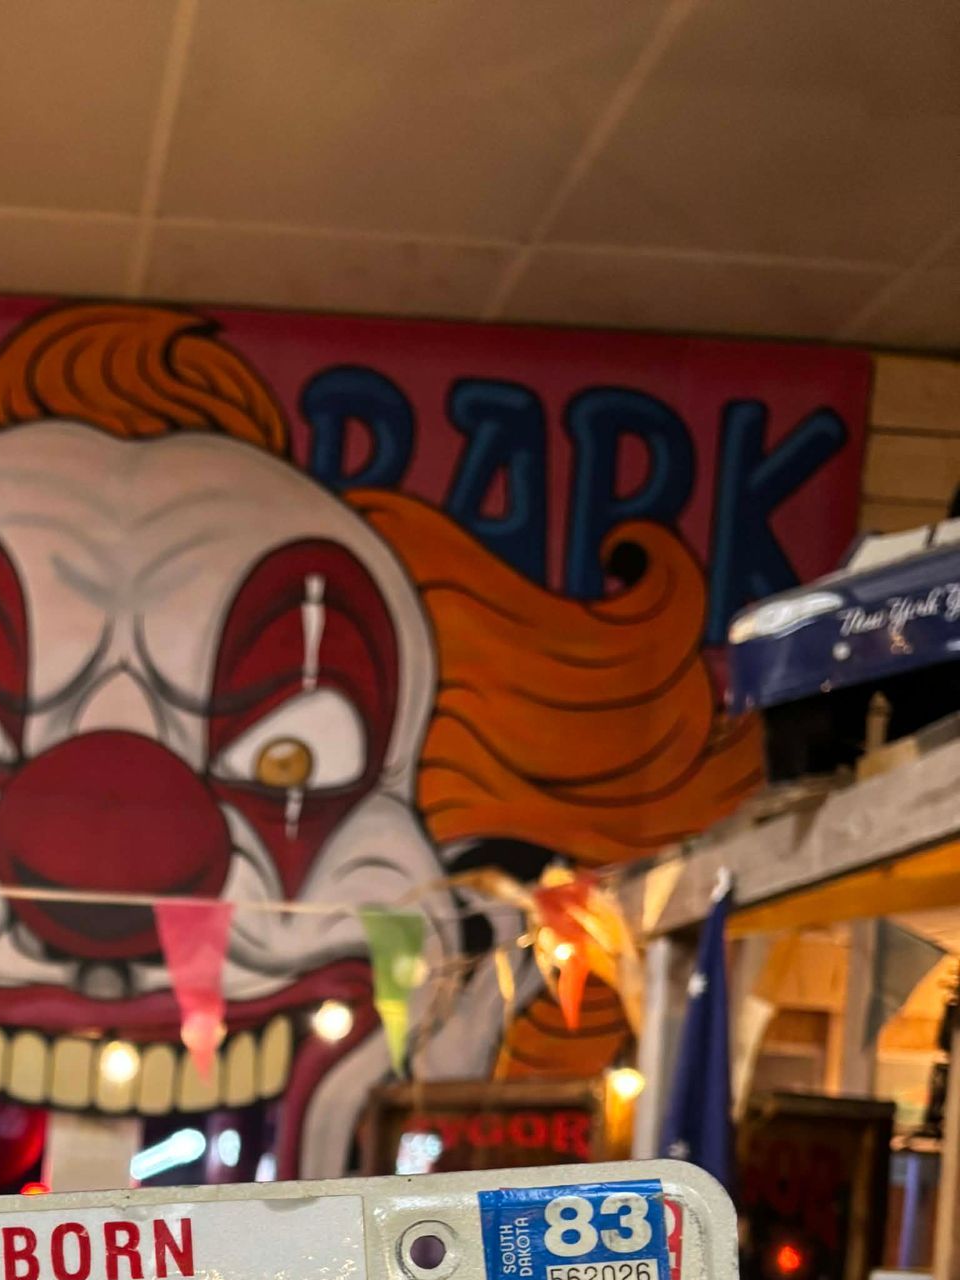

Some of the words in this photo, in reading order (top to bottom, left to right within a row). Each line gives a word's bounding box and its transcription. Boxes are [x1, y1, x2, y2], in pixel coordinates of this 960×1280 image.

[300, 363, 849, 646] PARK
[499, 1224, 516, 1274] SOUTH
[514, 1217, 534, 1277] DAKOTA
[544, 1191, 653, 1258] 83
